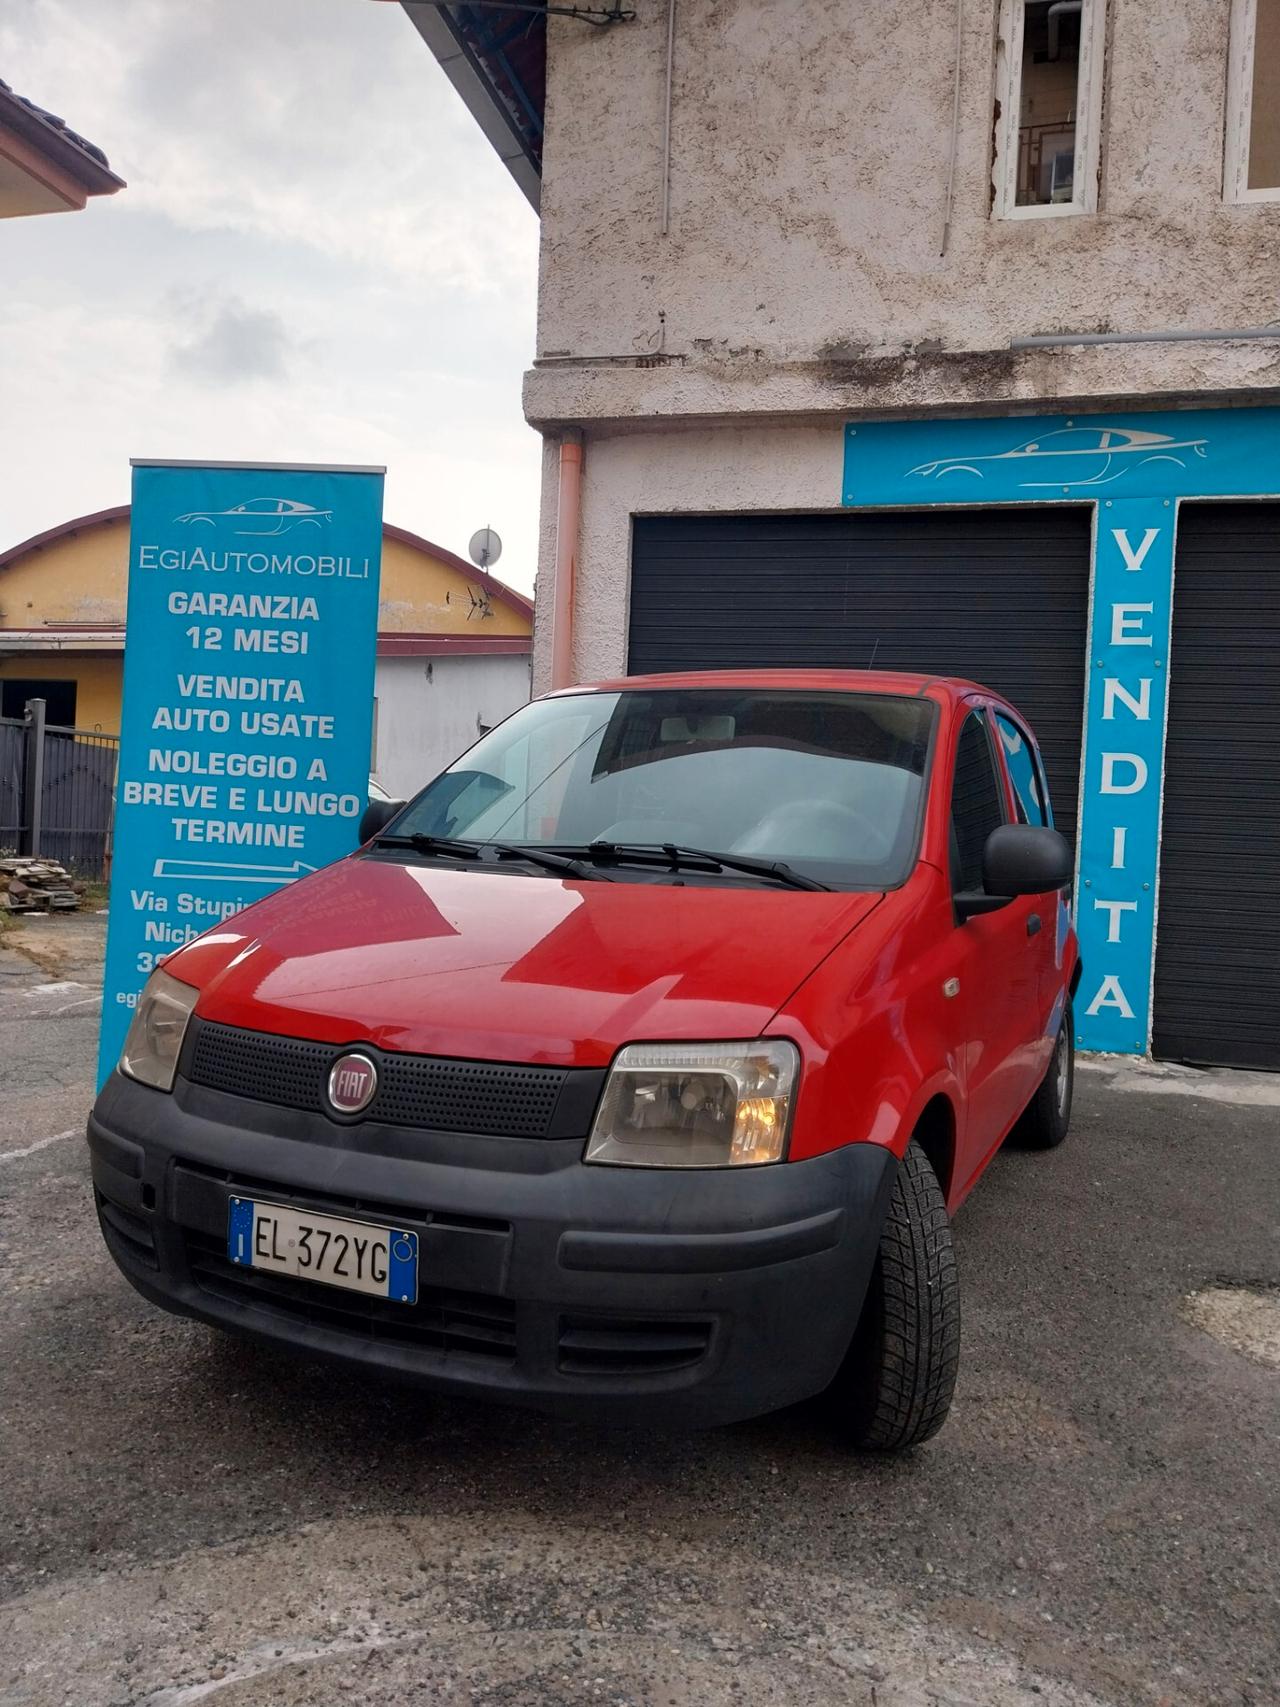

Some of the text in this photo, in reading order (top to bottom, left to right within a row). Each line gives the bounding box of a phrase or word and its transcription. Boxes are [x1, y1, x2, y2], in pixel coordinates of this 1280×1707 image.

[168, 591, 320, 621] GARANZIA
[186, 626, 309, 654] 12 MESI
[177, 674, 305, 703] VENDITA
[152, 707, 335, 739] AUTO USATE
[148, 749, 328, 782] NOLEGGIO A
[1085, 528, 1161, 1019] VENDITA
[123, 781, 360, 818] BREVE E LUNGO
[171, 818, 305, 848] TERMINE
[130, 889, 168, 913] Via
[335, 1070, 368, 1099] FIAT
[255, 1216, 388, 1284] EL 372YG
